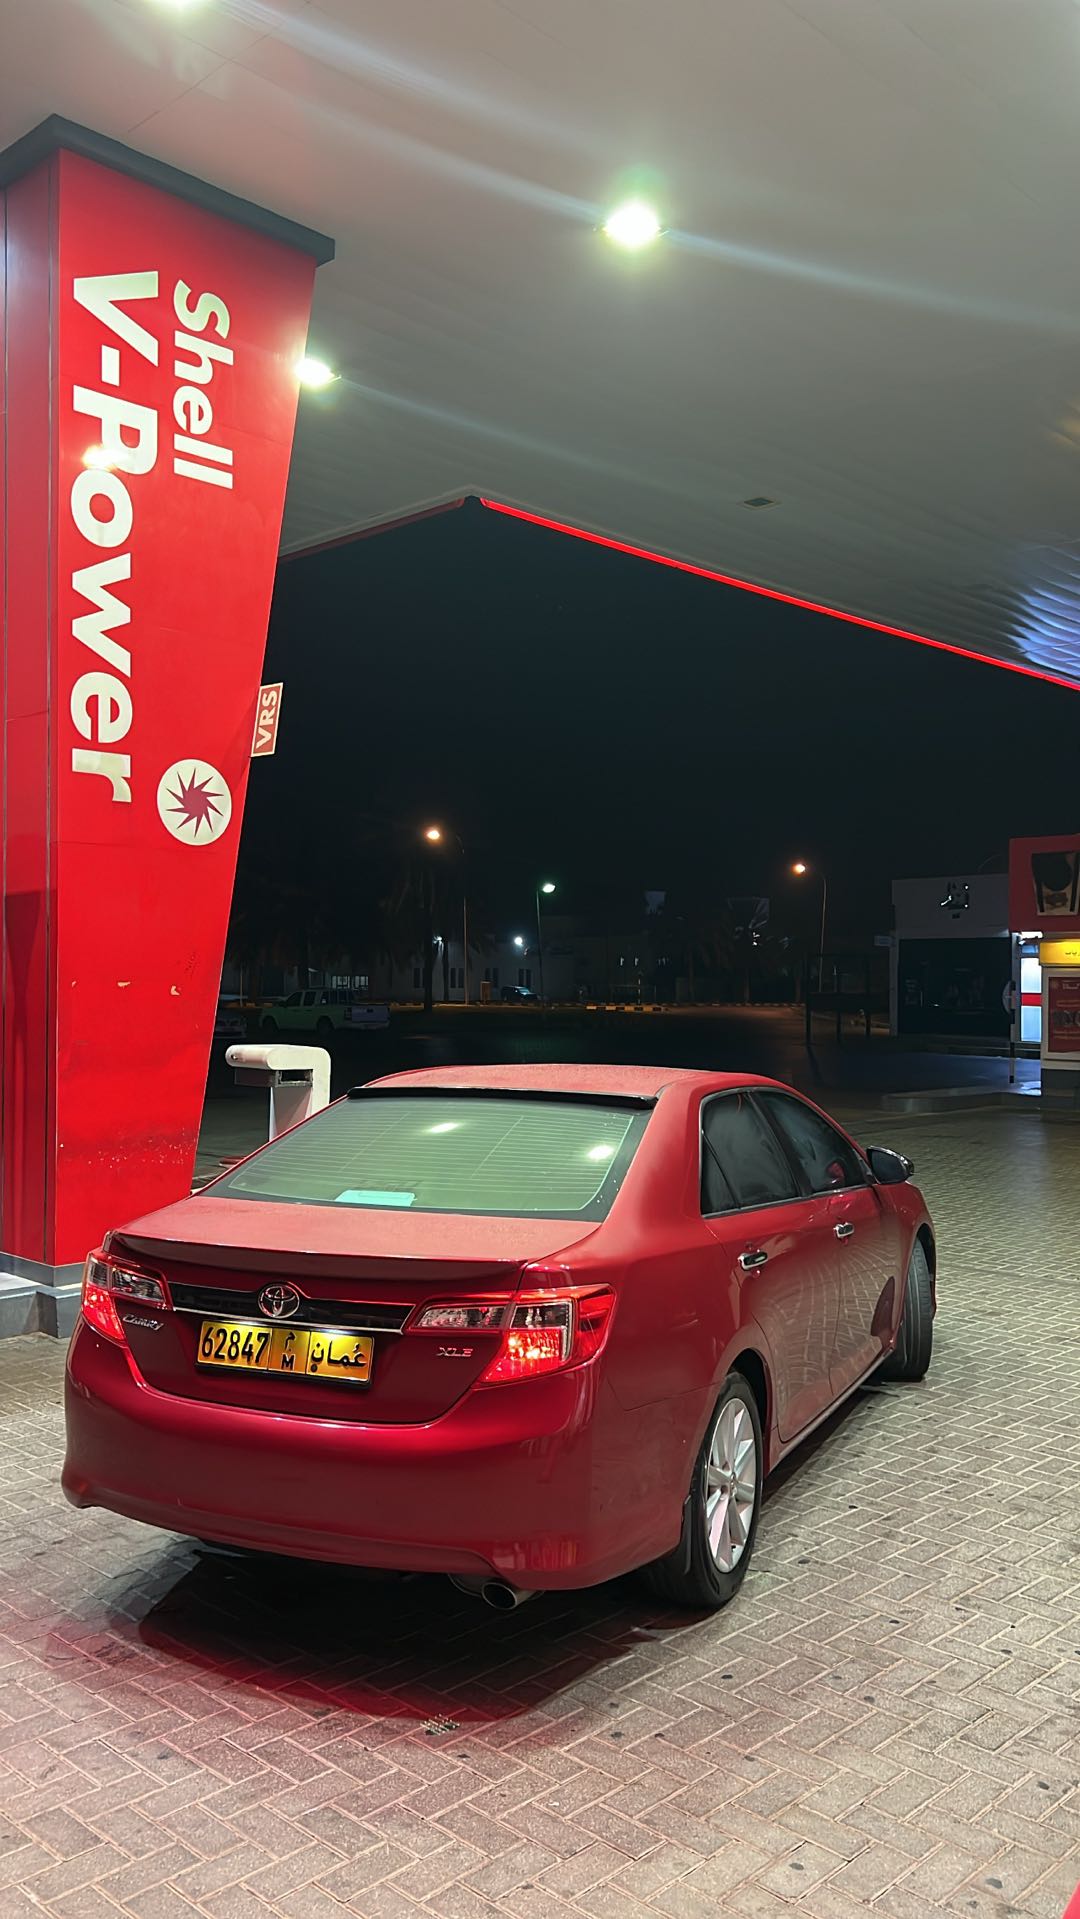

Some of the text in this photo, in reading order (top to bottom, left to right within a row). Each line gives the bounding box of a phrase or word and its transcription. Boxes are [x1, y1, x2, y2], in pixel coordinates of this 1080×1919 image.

[173, 279, 234, 489] Shell
[71, 270, 159, 803] V-Power
[256, 690, 278, 749] VRS
[201, 1326, 270, 1364] 62847
[281, 1354, 295, 1371] M
[436, 1347, 474, 1357] XLE
